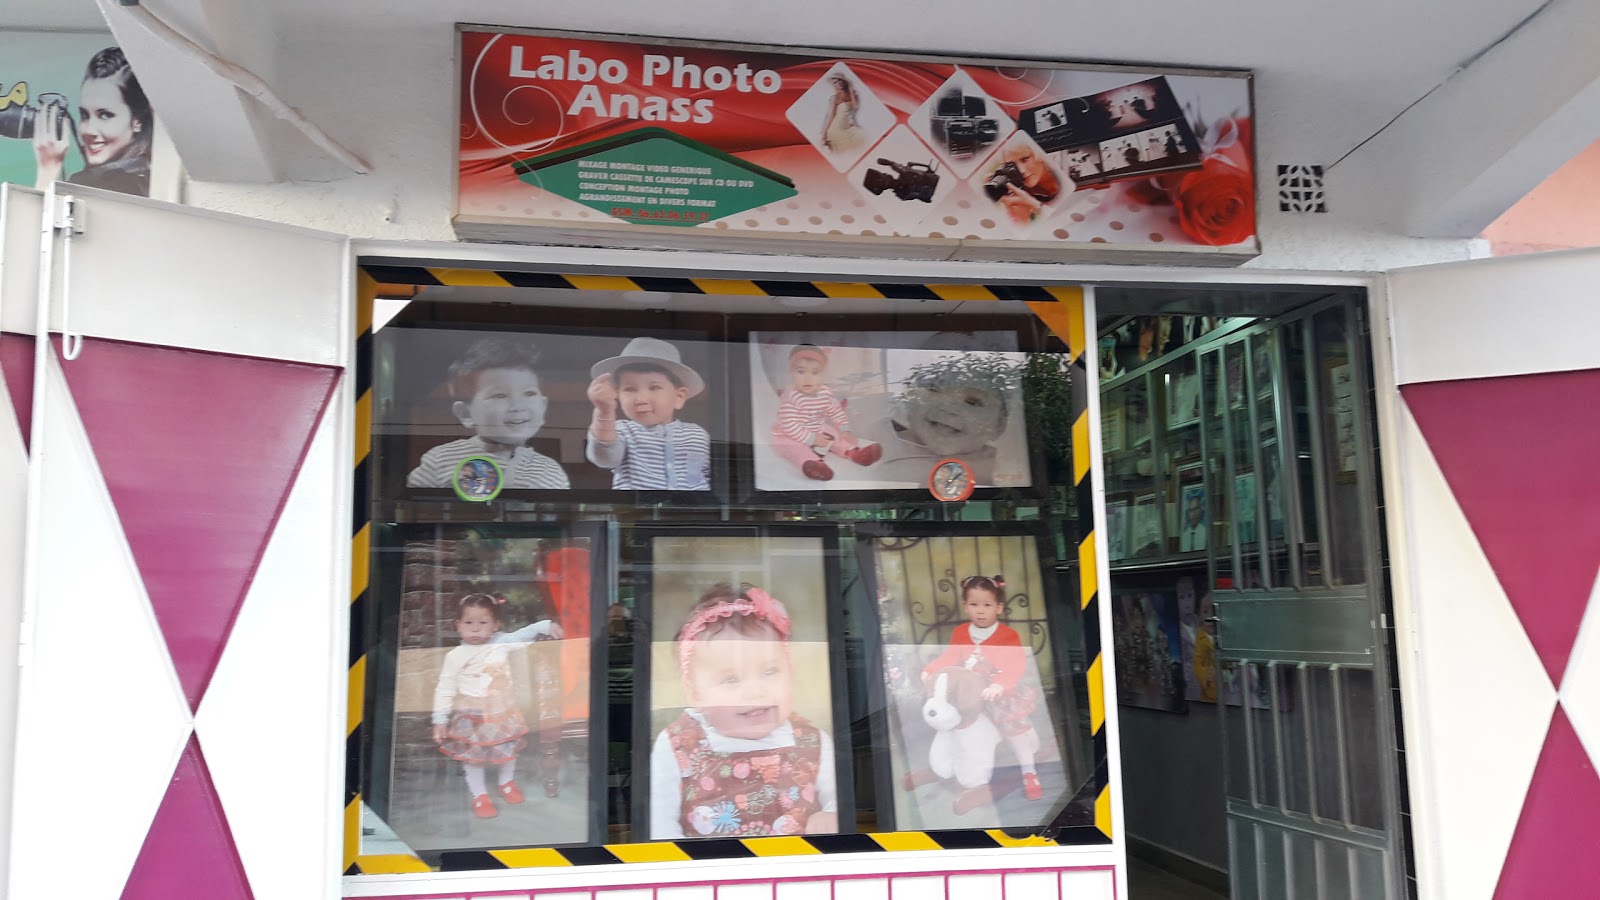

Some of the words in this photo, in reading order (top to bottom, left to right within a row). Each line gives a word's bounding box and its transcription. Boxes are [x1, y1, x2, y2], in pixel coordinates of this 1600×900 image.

[509, 46, 628, 84] Labo
[642, 54, 782, 94] Photo
[566, 84, 714, 124] Anass
[578, 160, 608, 169] MIXAGE
[609, 162, 646, 172] MONTAGE
[646, 164, 670, 173] VIDEO
[670, 166, 711, 175] GENERIQUE
[577, 171, 609, 180] GRAVER
[609, 173, 643, 182] CASSETTE
[644, 175, 654, 183] DE
[654, 176, 698, 185] CAMESCOPE
[699, 178, 714, 186] SUR
[714, 178, 725, 186] CD
[725, 179, 737, 187] OU
[737, 180, 755, 188] DVD
[579, 182, 626, 191] CONCEPTION
[627, 185, 663, 194] MONTAGE
[664, 187, 690, 195] PHOTO
[578, 193, 646, 204] AGRANDISSEMENT
[647, 197, 658, 205] EN
[658, 198, 686, 206] DIVERS
[687, 199, 716, 208] FORMAT
